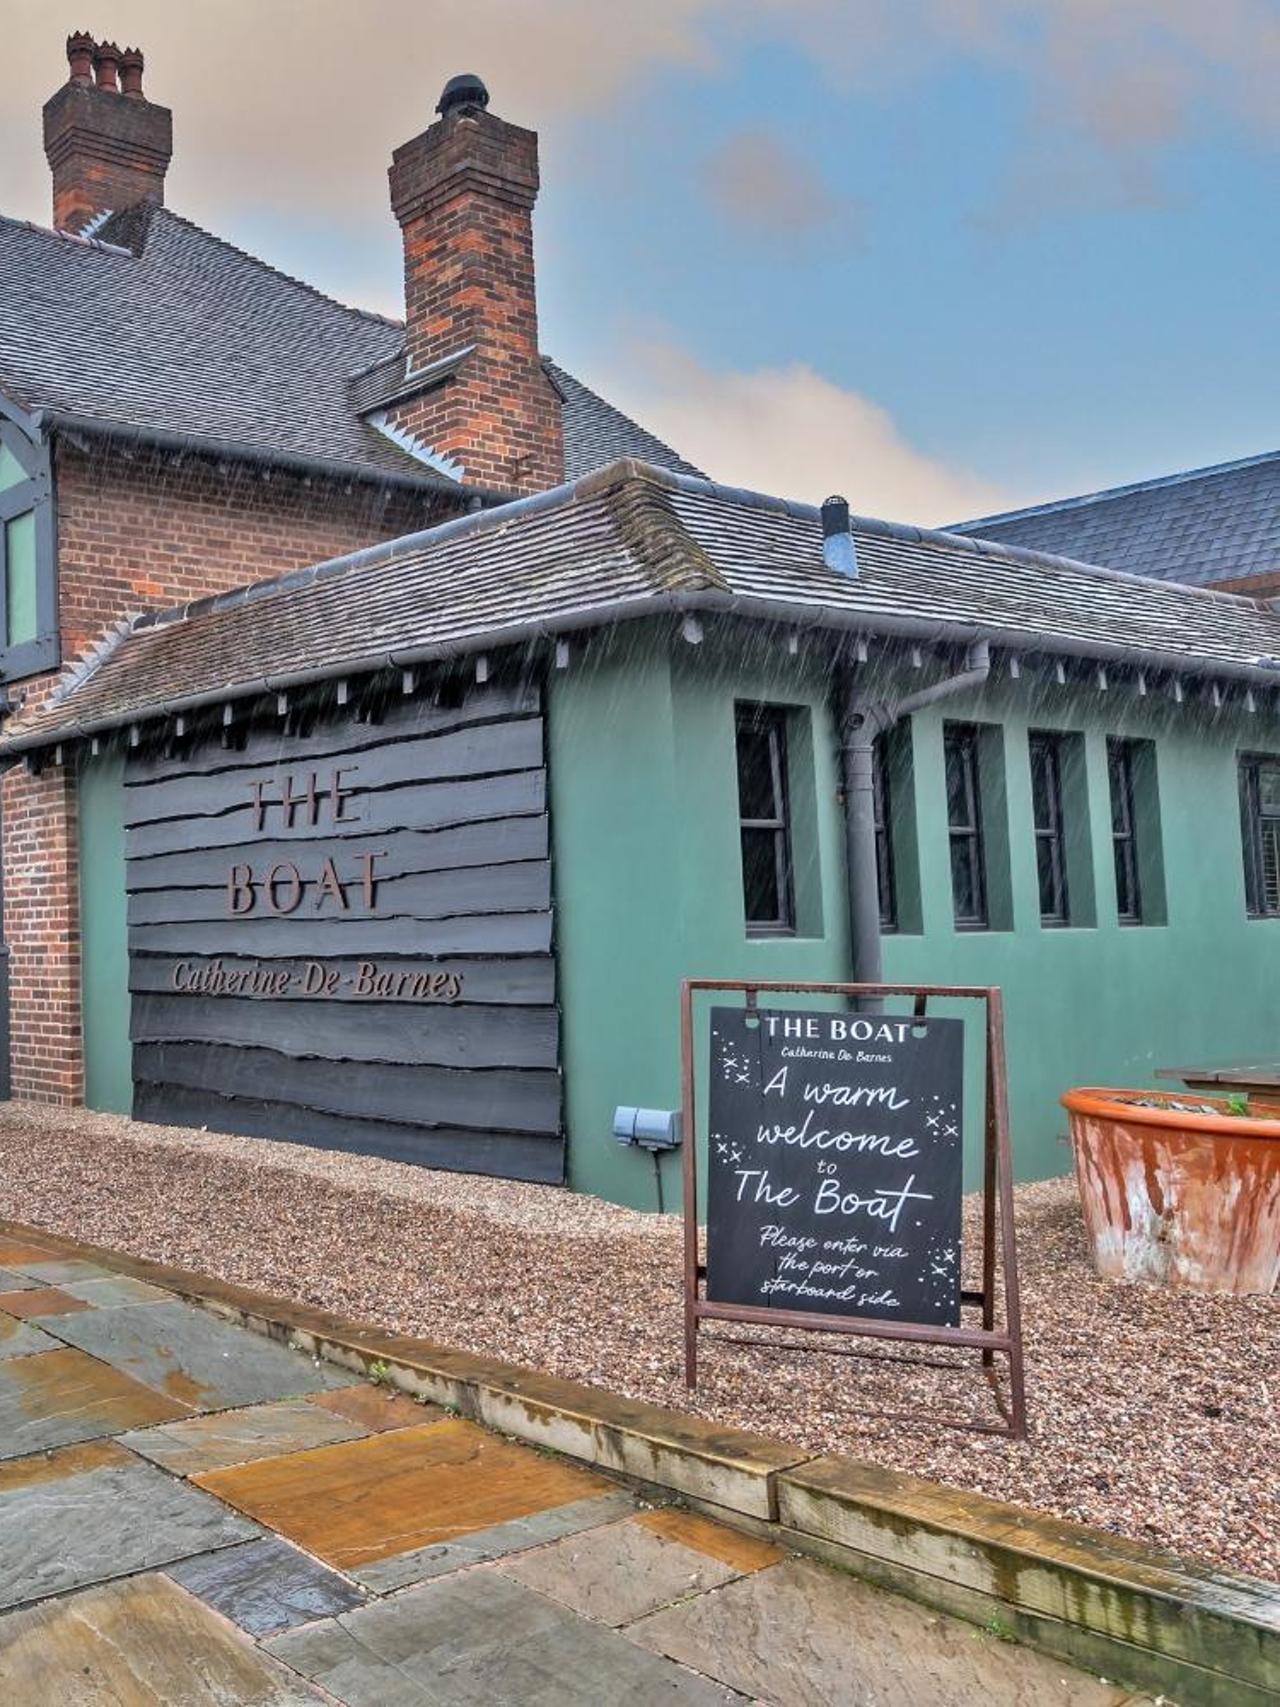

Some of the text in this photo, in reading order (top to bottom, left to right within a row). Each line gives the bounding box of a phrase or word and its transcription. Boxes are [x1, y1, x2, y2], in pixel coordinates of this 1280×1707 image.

[248, 766, 361, 831] THE
[227, 852, 388, 914] BOAT
[765, 1017, 910, 1043] THE BOAT
[856, 1051, 892, 1063] Barnes
[763, 1065, 911, 1110] A warm
[757, 1109, 920, 1158] welcome
[817, 1159, 838, 1175] to
[734, 1170, 934, 1233] The Boat
[760, 1225, 909, 1257] Please enter via
[778, 1252, 880, 1279] the port or
[760, 1275, 901, 1307] starboard side
